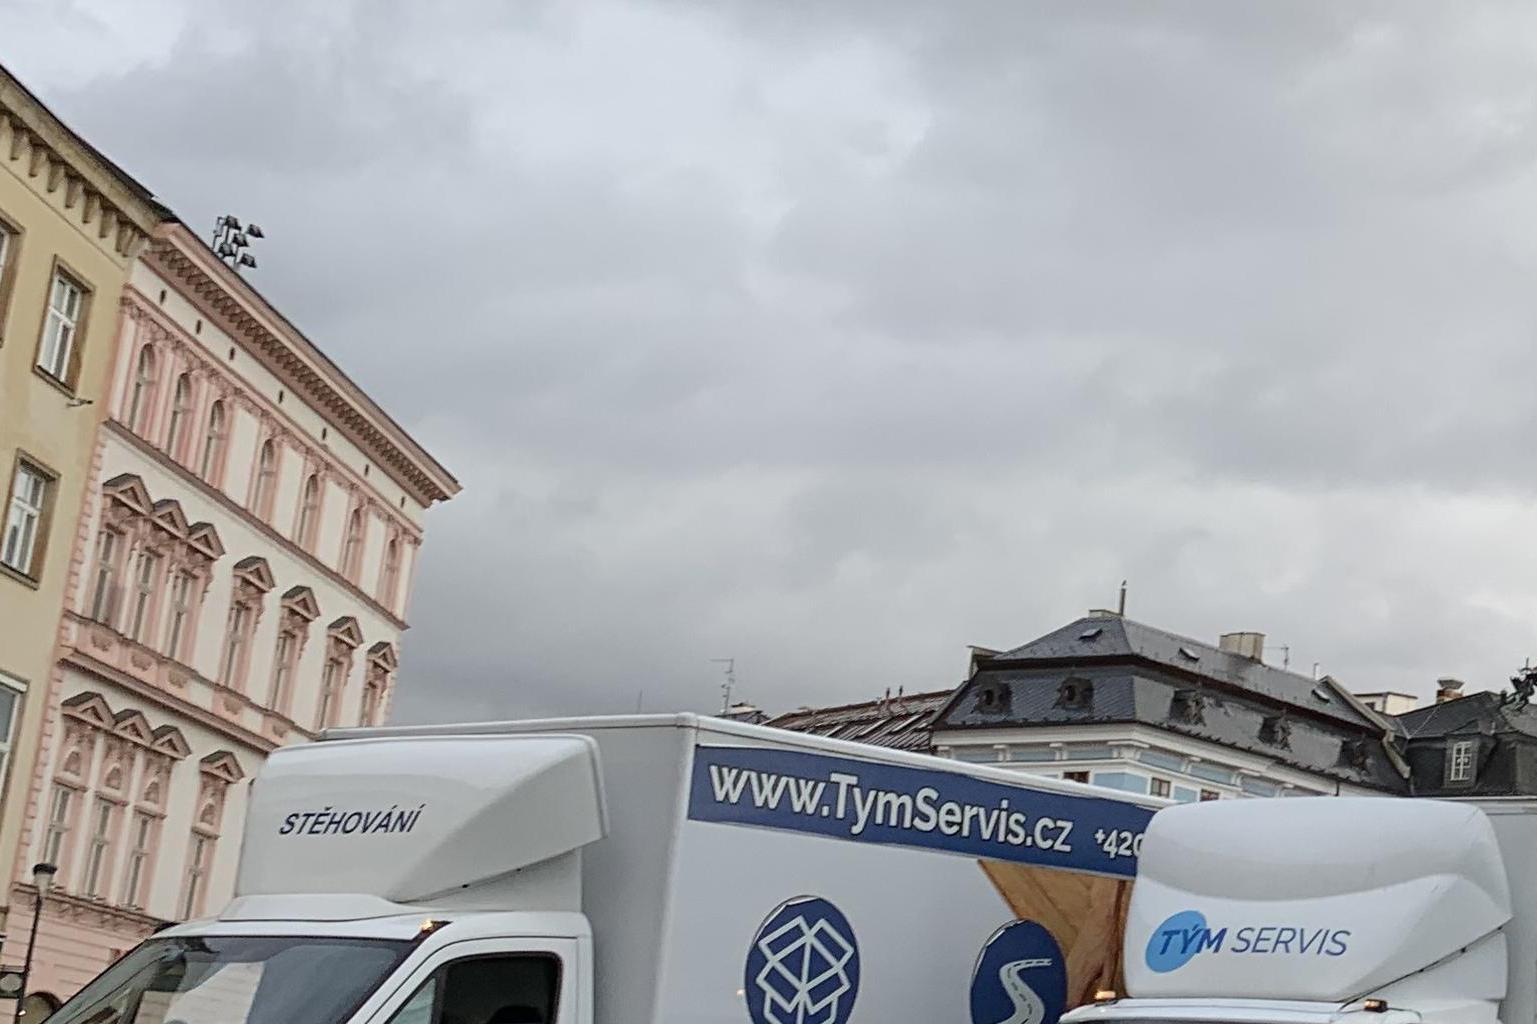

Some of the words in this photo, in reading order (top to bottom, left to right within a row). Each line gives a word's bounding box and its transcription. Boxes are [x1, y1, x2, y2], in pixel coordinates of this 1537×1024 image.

[279, 803, 426, 835] STĚHOVÁNÍ
[709, 764, 1074, 852] www.TymServis.cz
[1159, 923, 1228, 955] TÝM
[1230, 926, 1351, 957] SERVIS
